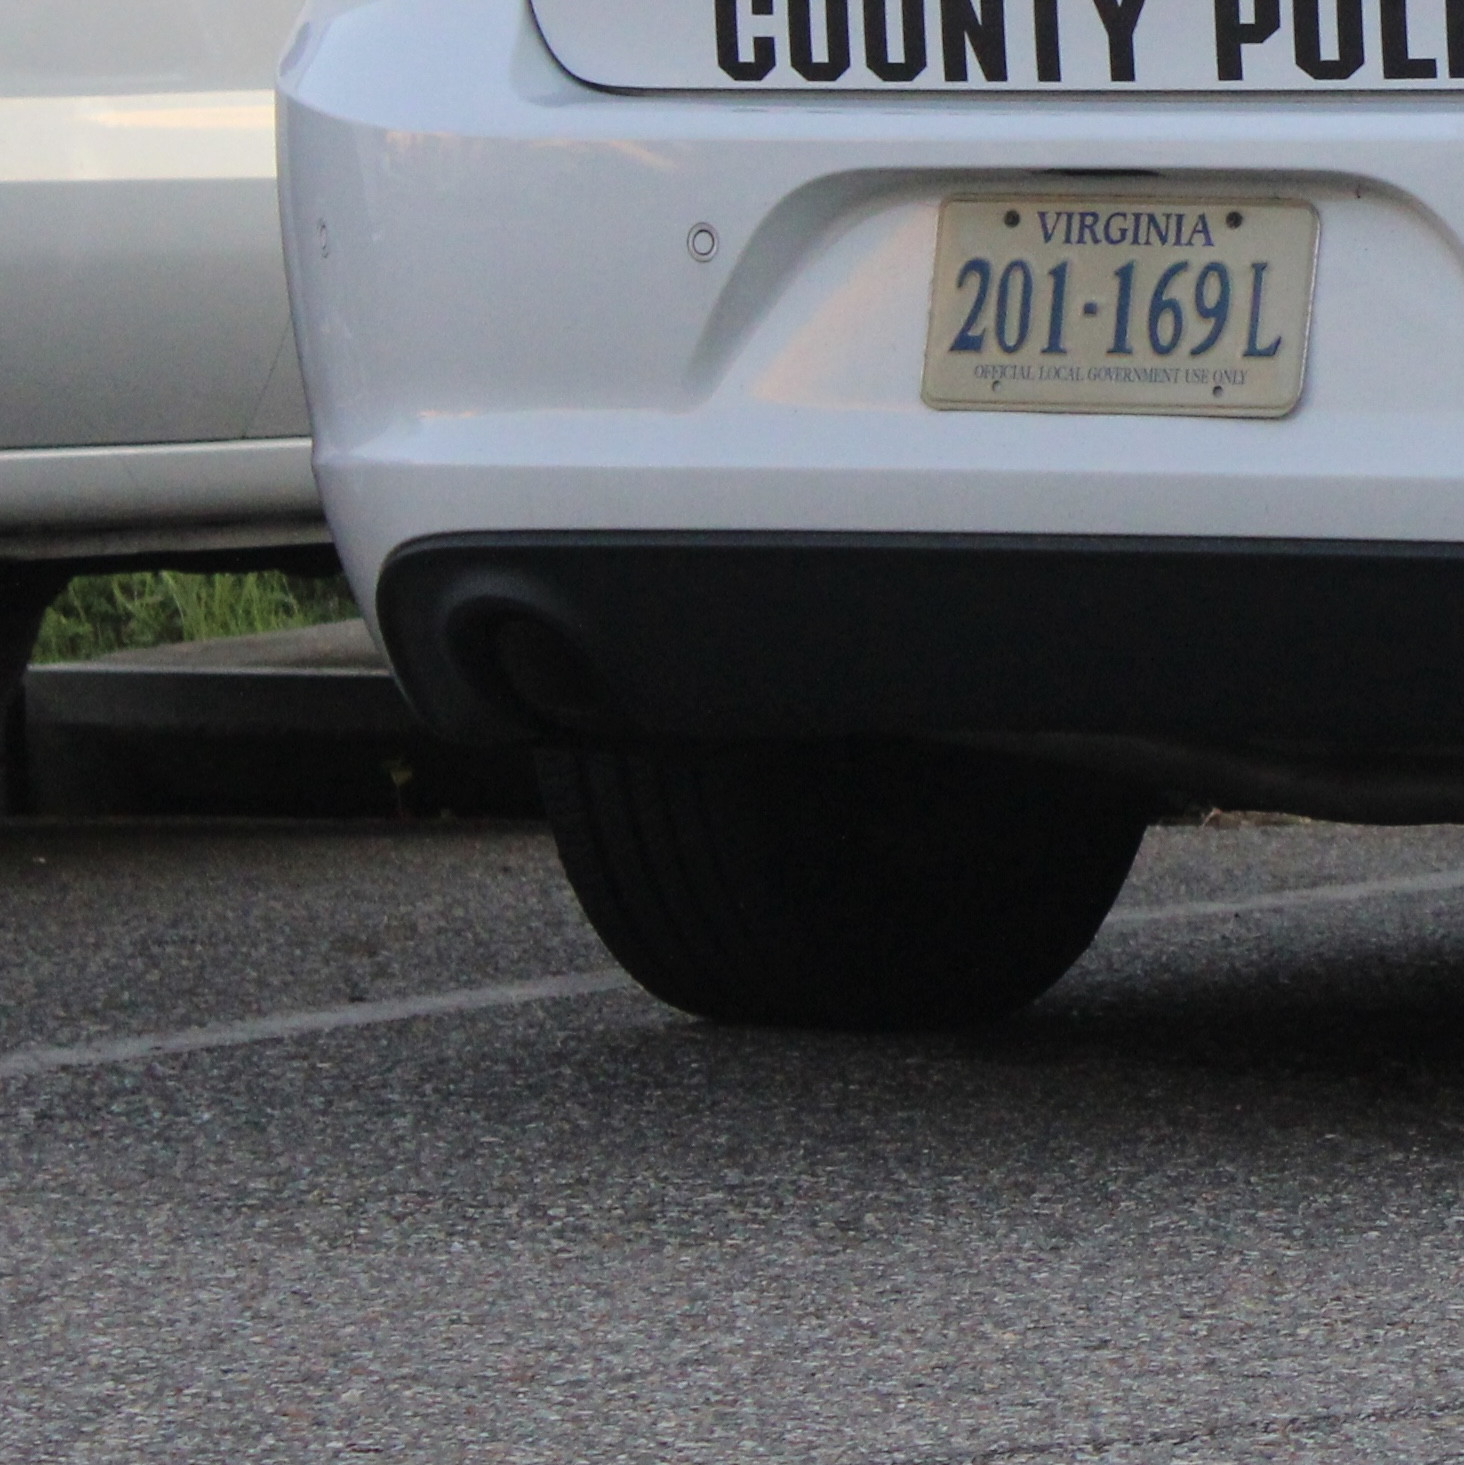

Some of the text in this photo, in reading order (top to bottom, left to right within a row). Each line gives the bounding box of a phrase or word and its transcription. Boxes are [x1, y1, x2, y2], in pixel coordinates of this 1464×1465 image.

[1036, 210, 1216, 247] VIRGINIA
[974, 364, 1249, 386] OFFICIAL LOCAL GOVERNMENT USE ONLY
